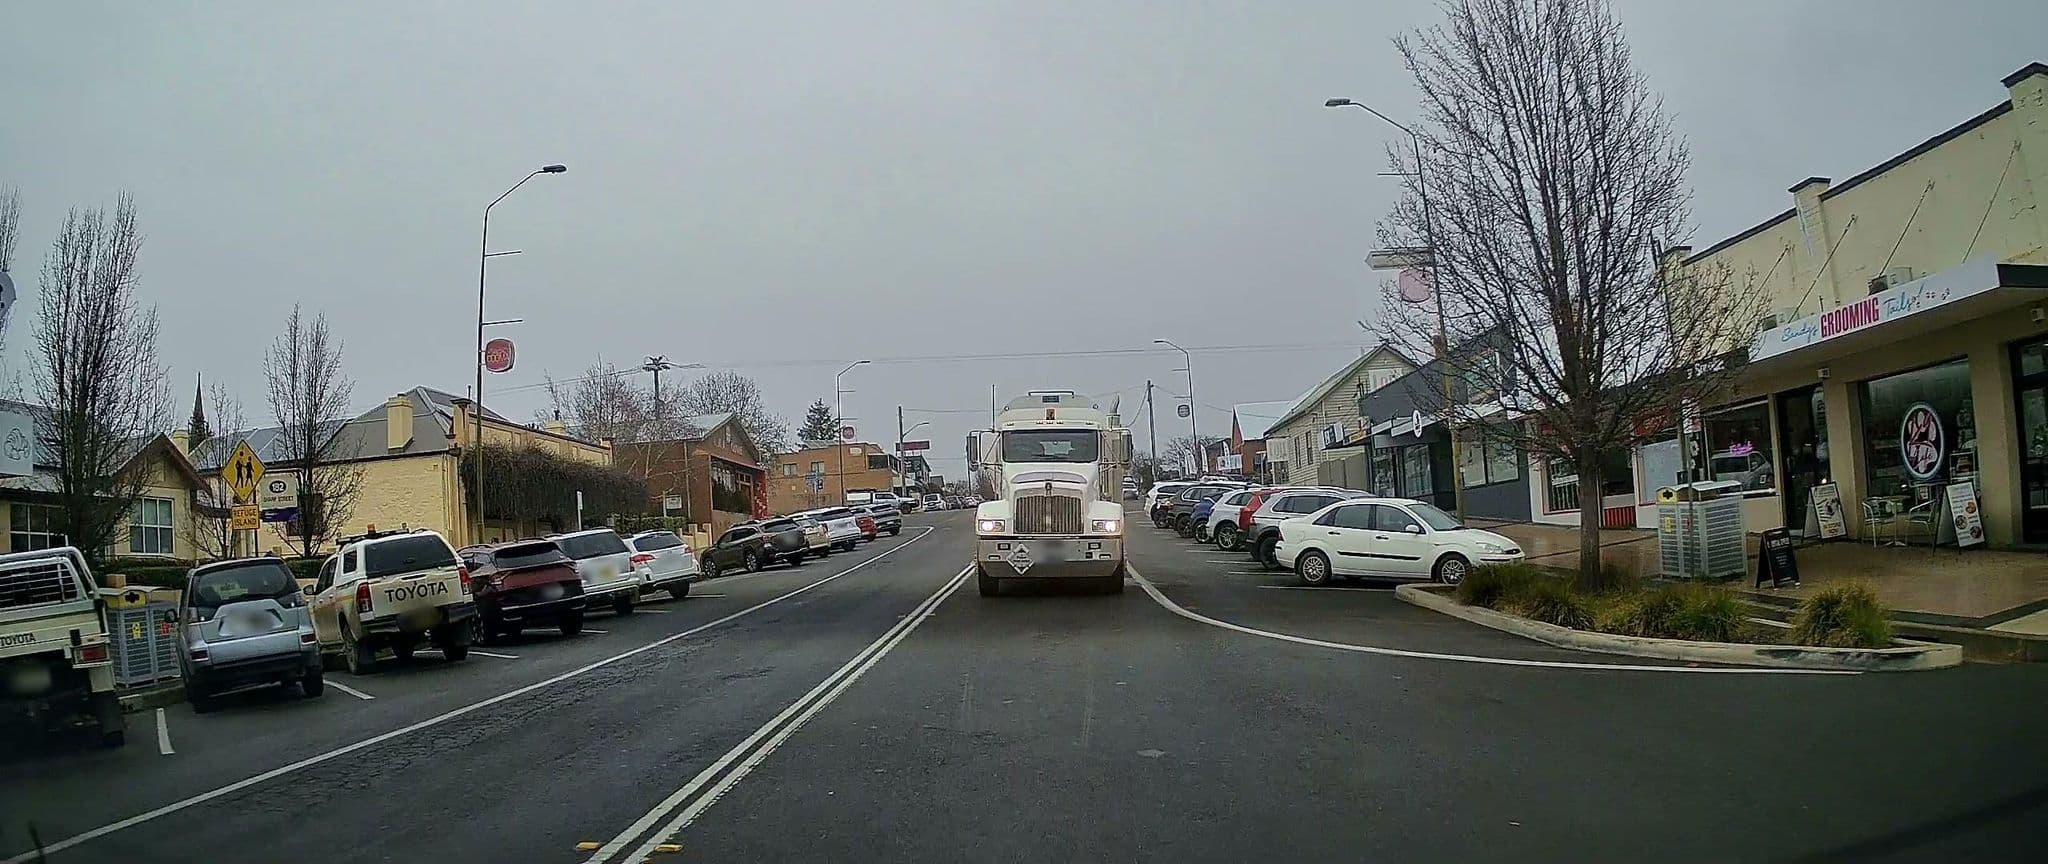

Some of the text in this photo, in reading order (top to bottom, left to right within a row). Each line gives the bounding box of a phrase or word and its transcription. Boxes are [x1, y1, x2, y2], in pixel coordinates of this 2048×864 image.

[1820, 297, 1880, 338] GROOMING
[233, 508, 257, 517] REFUGE
[235, 518, 257, 526] ISLAND
[384, 581, 448, 602] TOYOTA
[0, 632, 36, 646] TOYOTA
